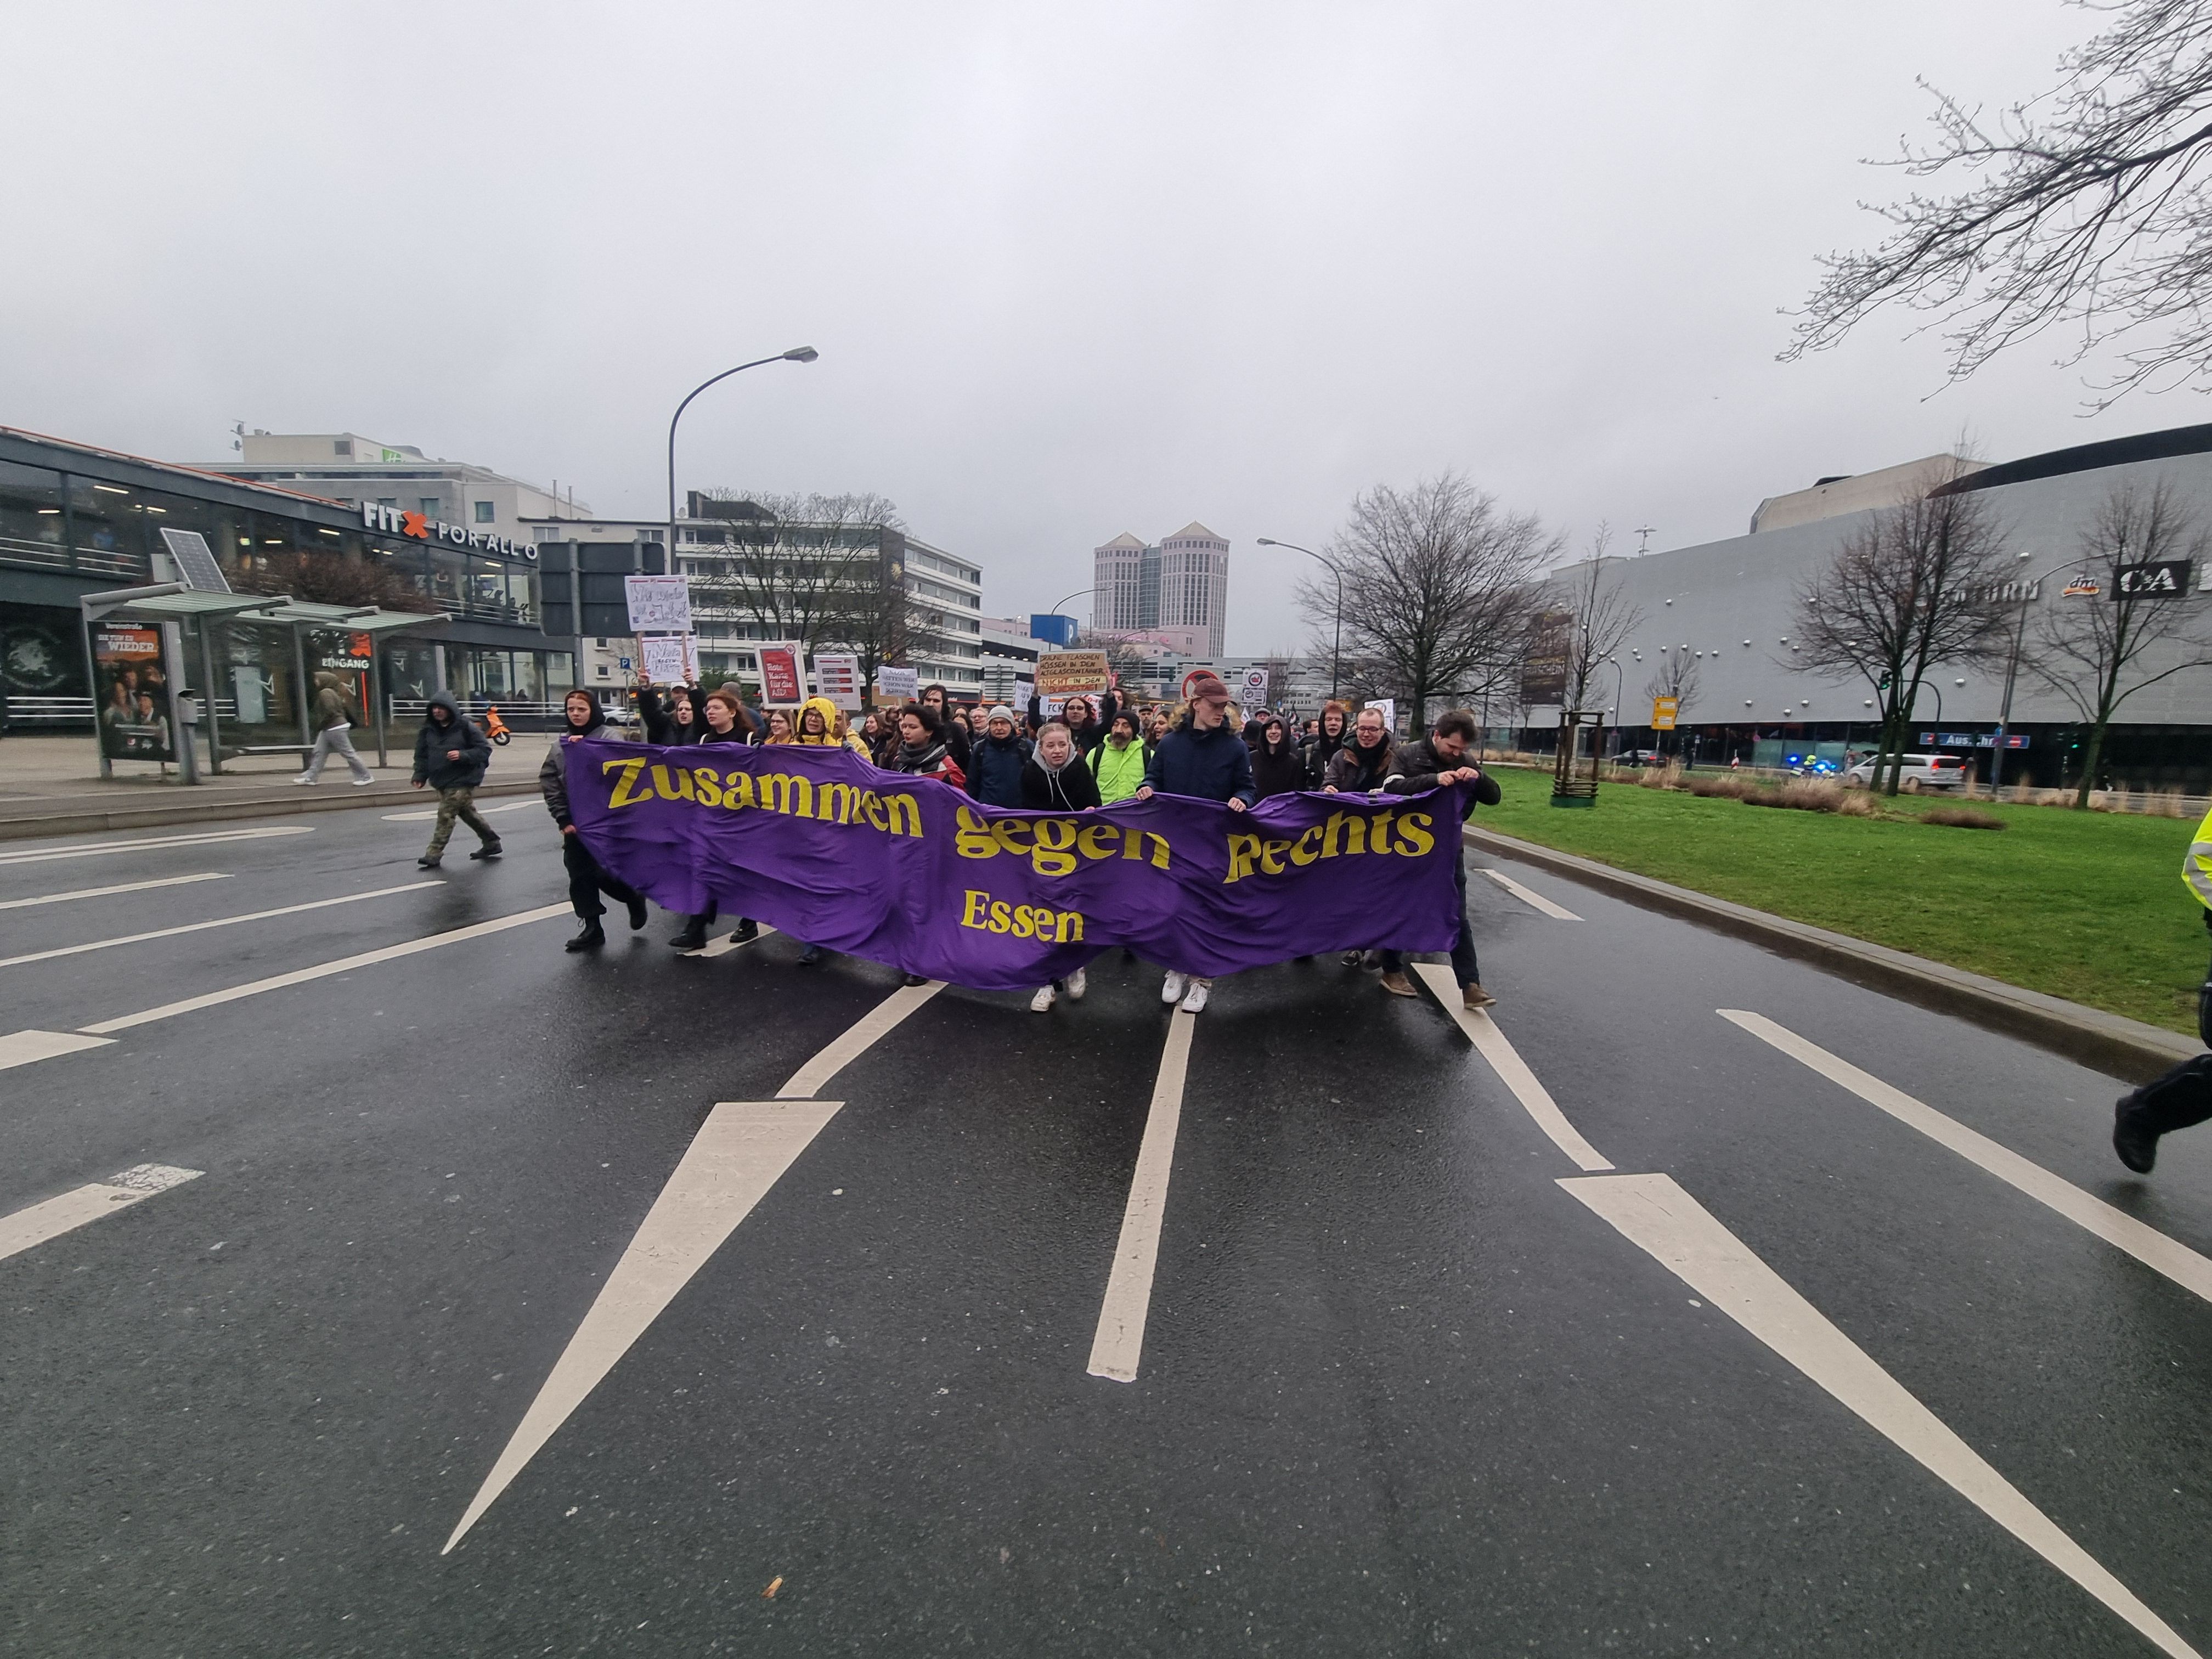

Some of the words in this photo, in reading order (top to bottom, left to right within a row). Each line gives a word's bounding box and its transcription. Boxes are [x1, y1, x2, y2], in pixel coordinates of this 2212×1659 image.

[437, 521, 479, 548] FOR
[487, 534, 519, 556] ALL
[525, 544, 538, 560] O
[2070, 575, 2096, 588] dm
[322, 658, 369, 669] EINGANG
[1042, 678, 1069, 686] NICHT
[1946, 735, 1995, 747] Aushr
[602, 757, 923, 838] Zusammen
[955, 805, 1171, 876] gegen
[1223, 809, 1435, 884] Rechts
[960, 889, 1084, 943] Essen
